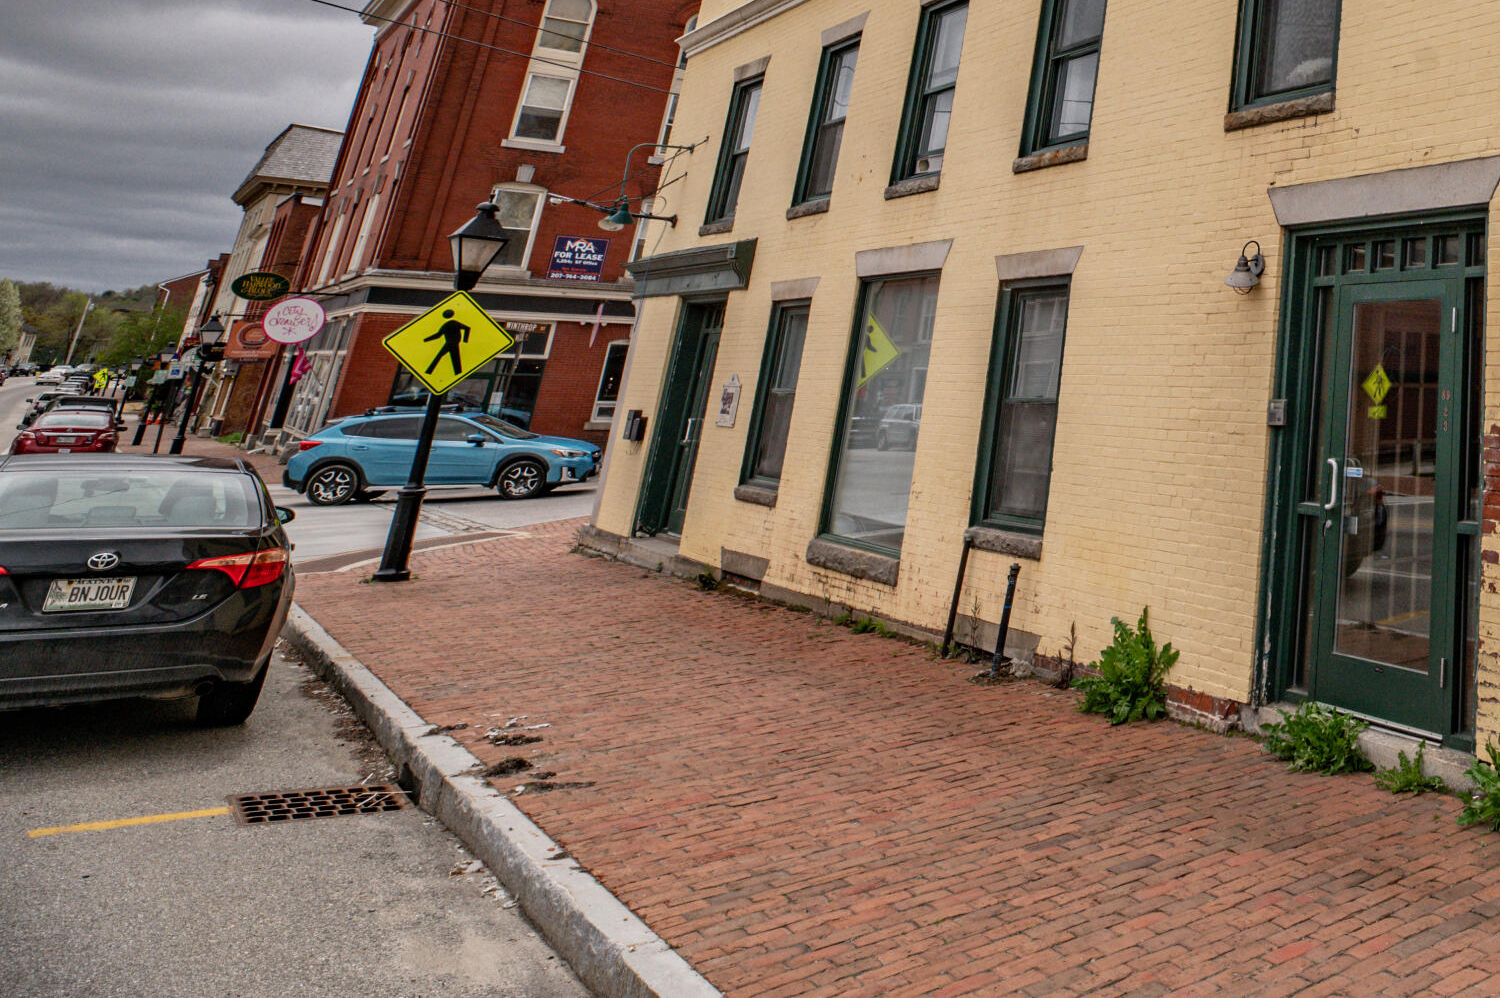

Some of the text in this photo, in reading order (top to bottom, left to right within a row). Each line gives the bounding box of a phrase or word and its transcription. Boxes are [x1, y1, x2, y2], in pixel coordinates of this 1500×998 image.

[565, 240, 595, 253] MRA
[554, 251, 604, 261] FOR LEASE
[506, 322, 537, 331] WINTHROP
[68, 585, 129, 602] BNJOUR
